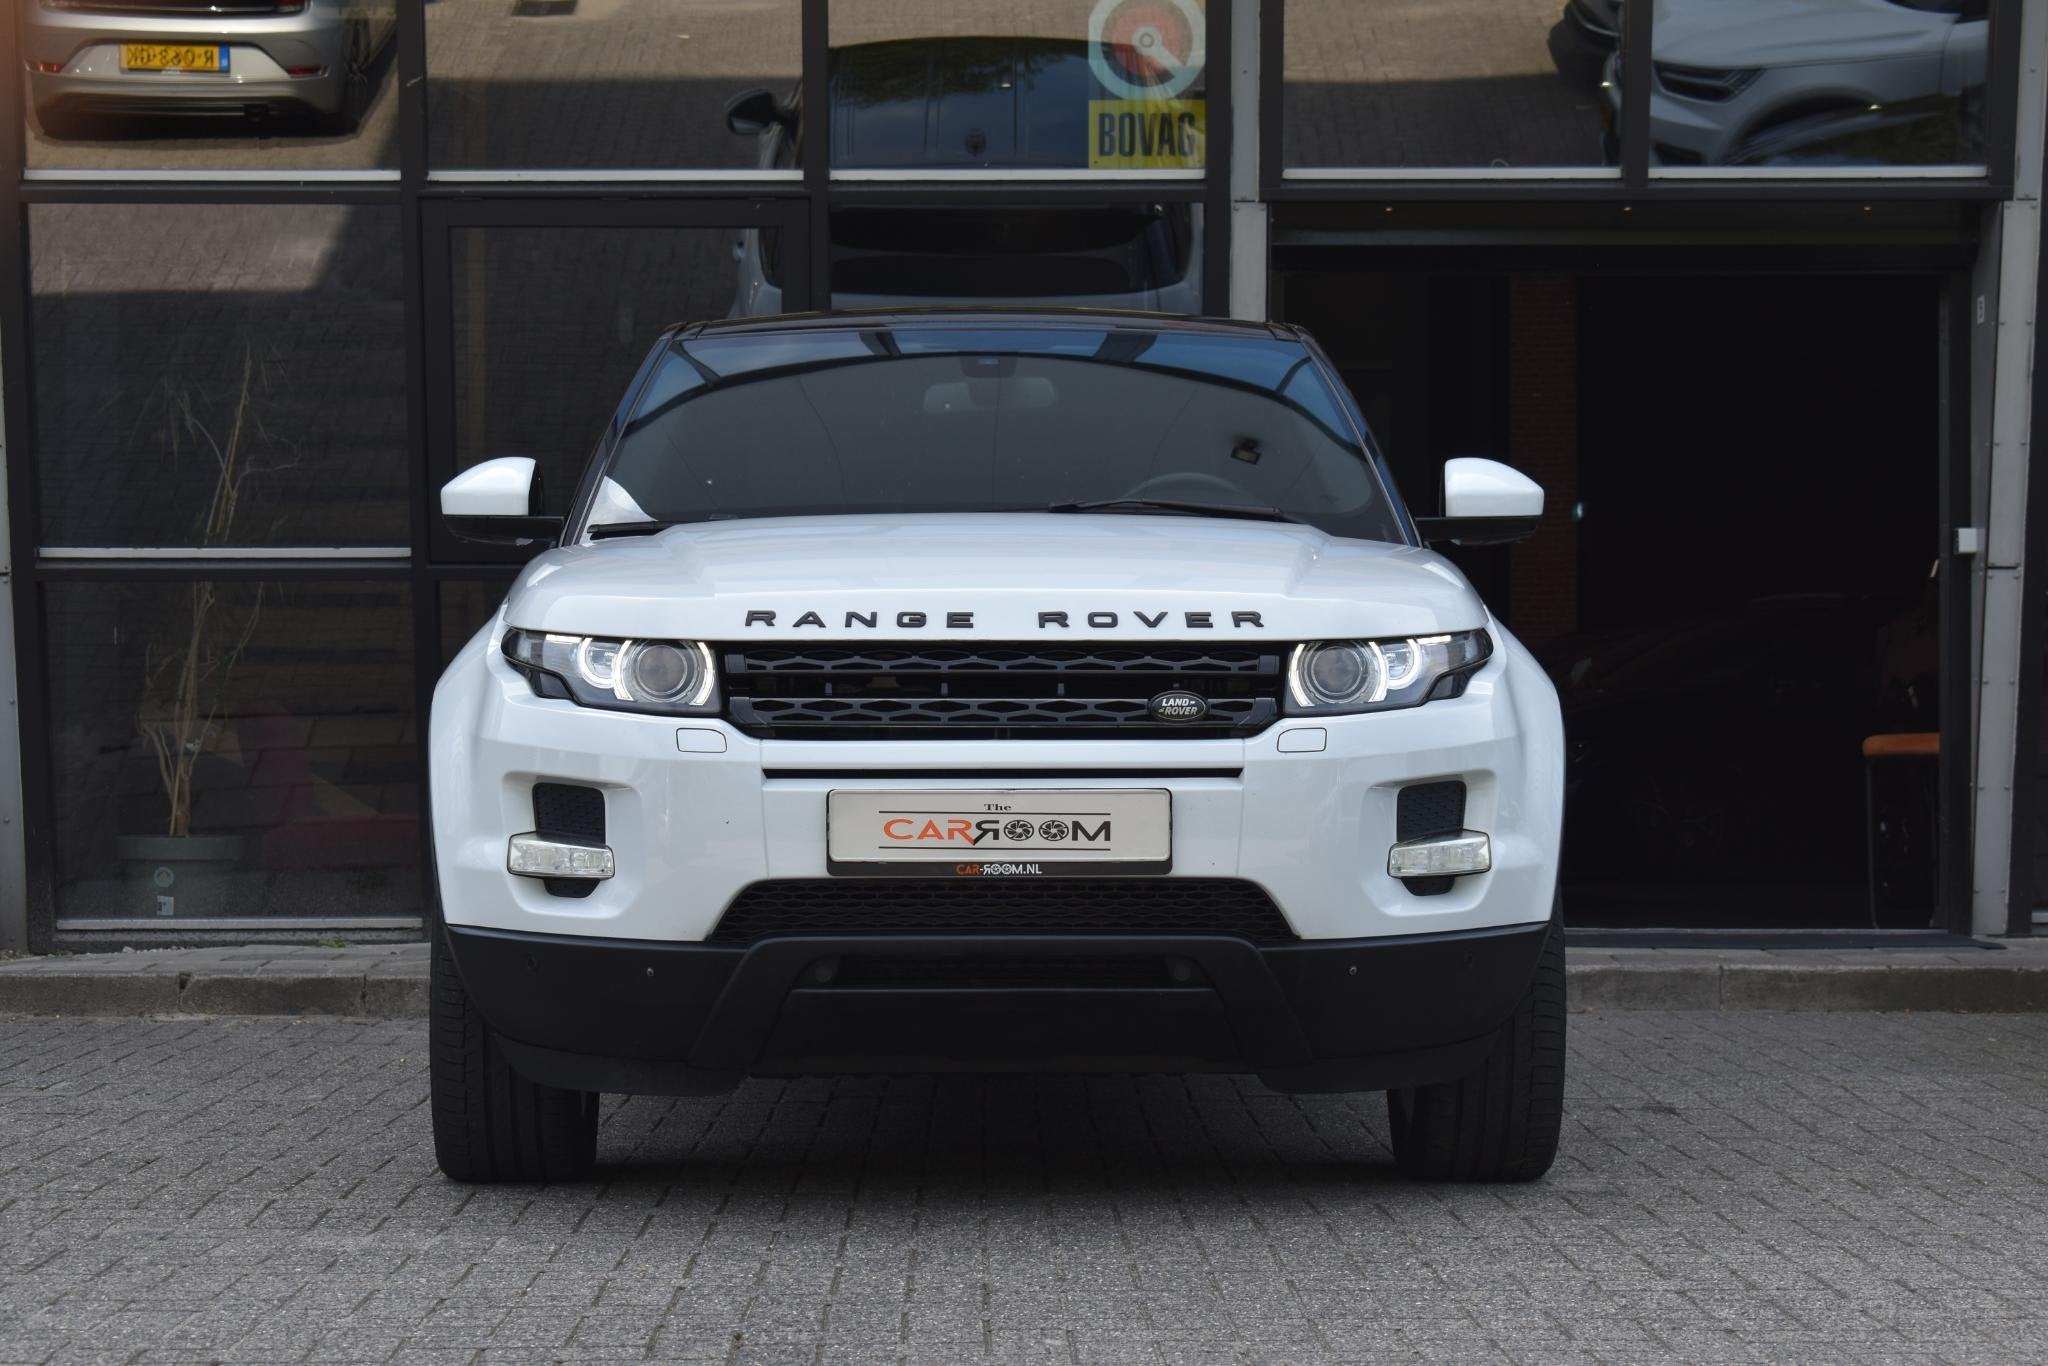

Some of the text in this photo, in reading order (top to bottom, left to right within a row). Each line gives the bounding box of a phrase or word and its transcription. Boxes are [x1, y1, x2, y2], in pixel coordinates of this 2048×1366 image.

[1098, 111, 1196, 157] BOVAG
[744, 609, 1265, 629] RANGE ROVER
[1161, 698, 1190, 707] LAND
[1164, 706, 1198, 715] ROVER
[983, 803, 1012, 811] The
